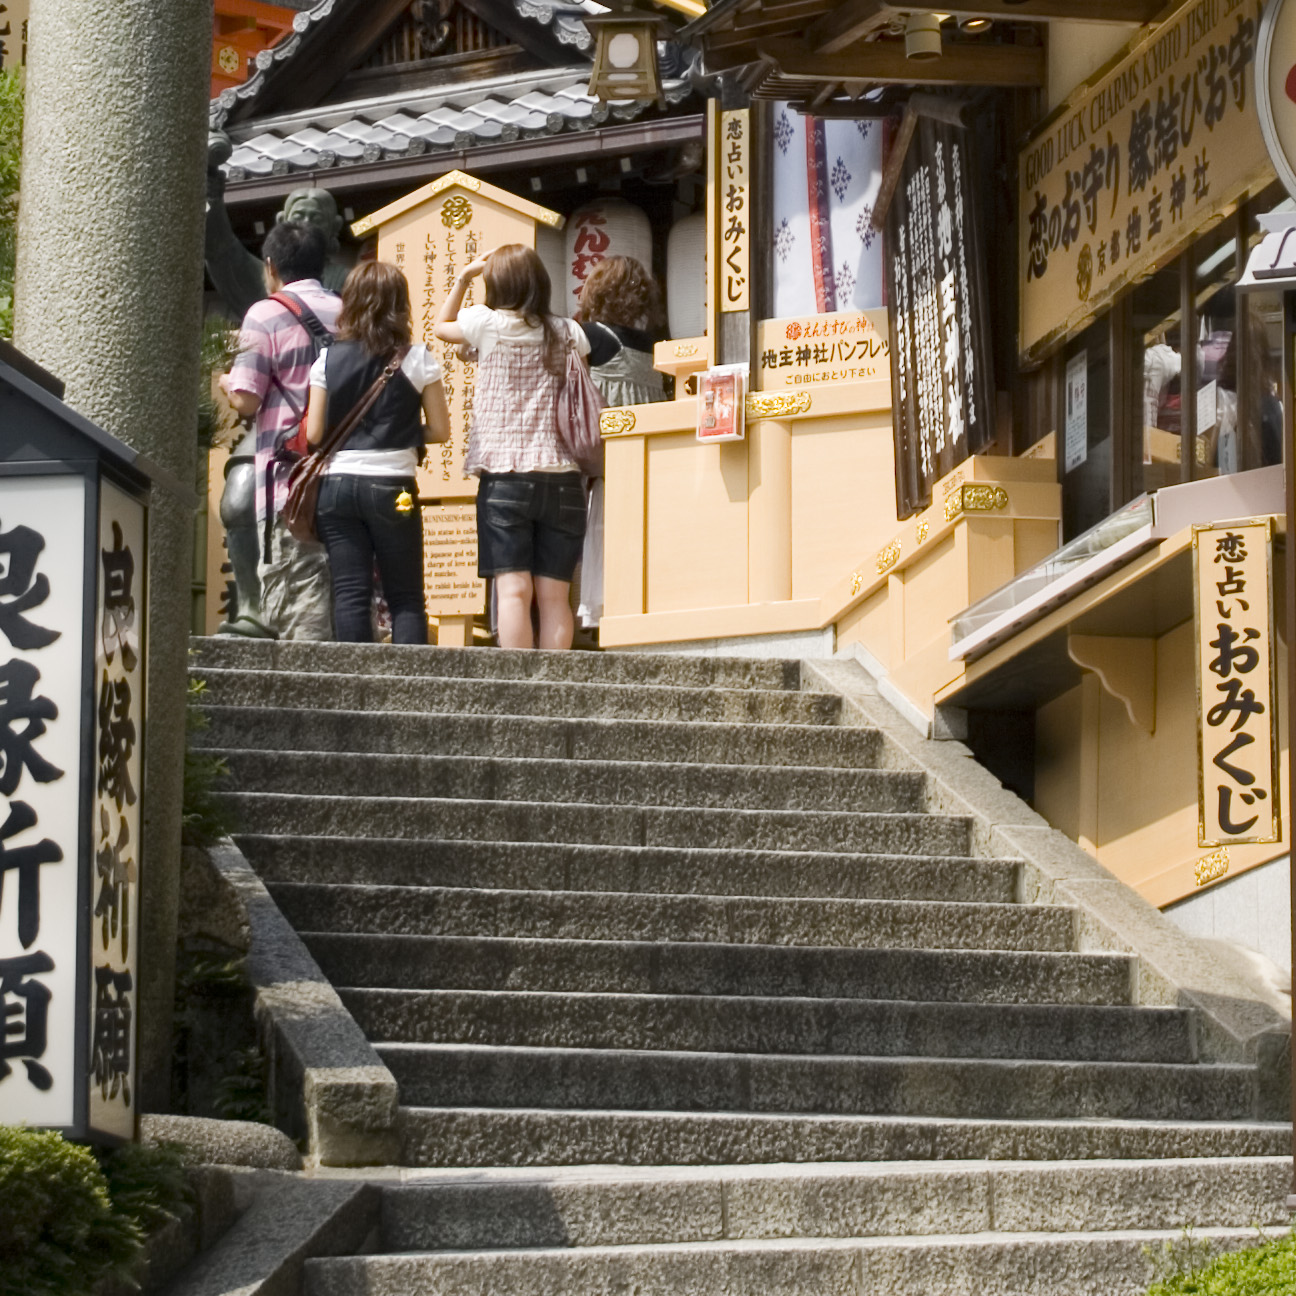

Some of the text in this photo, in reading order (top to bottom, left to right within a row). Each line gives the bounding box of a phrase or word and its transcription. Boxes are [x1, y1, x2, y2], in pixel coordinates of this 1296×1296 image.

[1025, 135, 1054, 191] GOOD
[1057, 106, 1087, 165] LUCK
[1090, 59, 1140, 135] CHARMS
[1143, 23, 1184, 85] KYOTO
[724, 118, 750, 303] 恋占いおみくじ
[1028, 130, 1121, 283] 恋のお守り
[785, 367, 876, 385] ご自由におとり下さい
[1205, 531, 1268, 837] 恋占いおみくじ
[88, 521, 139, 1108] 良縁祈願
